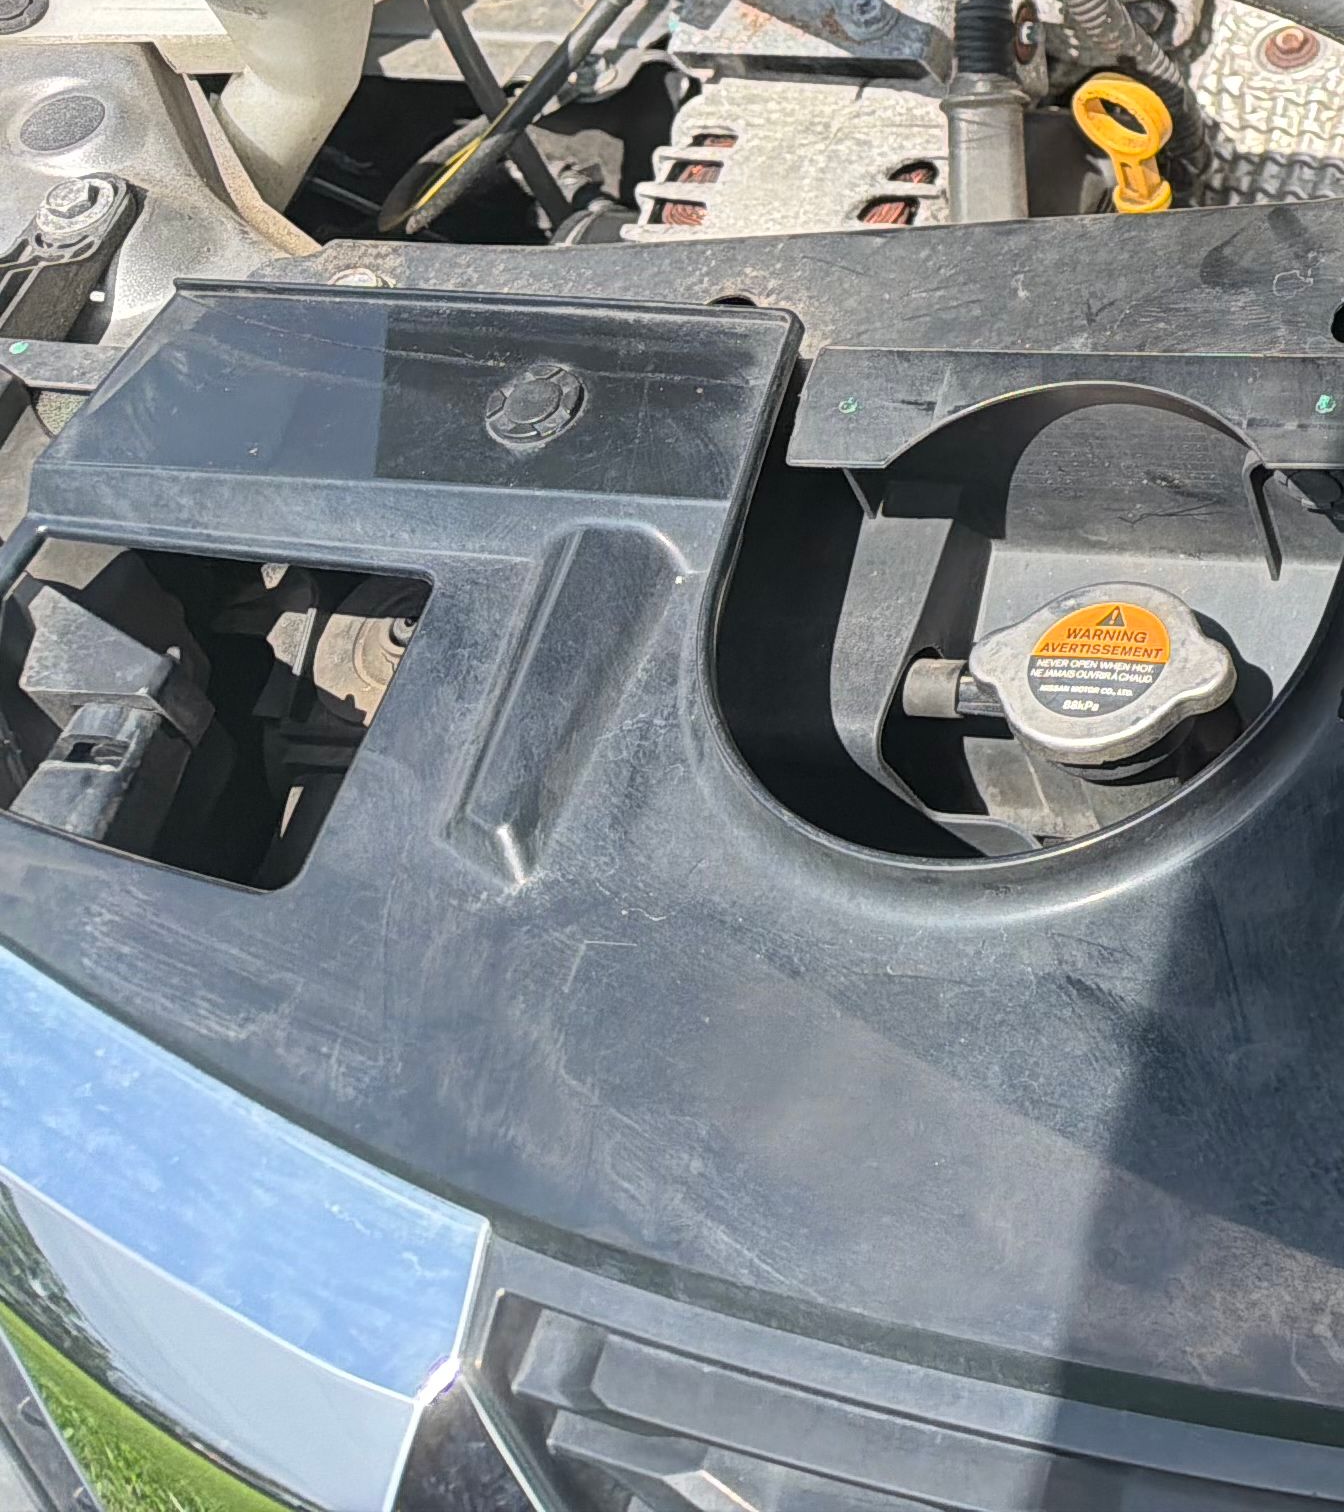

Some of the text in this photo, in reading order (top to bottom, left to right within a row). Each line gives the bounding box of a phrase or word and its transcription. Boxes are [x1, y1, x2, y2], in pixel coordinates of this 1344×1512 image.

[1066, 627, 1148, 644] WARNING
[1040, 642, 1163, 659] AVERTISSEMENT
[1036, 658, 1069, 668] NEVER
[1070, 659, 1098, 669] OPEN
[1100, 661, 1131, 671] WHEN
[1030, 668, 1043, 677] NE
[1043, 669, 1075, 678] JAMAIS
[1076, 670, 1110, 680] OUVRIR
[1070, 685, 1100, 694] MOTOR
